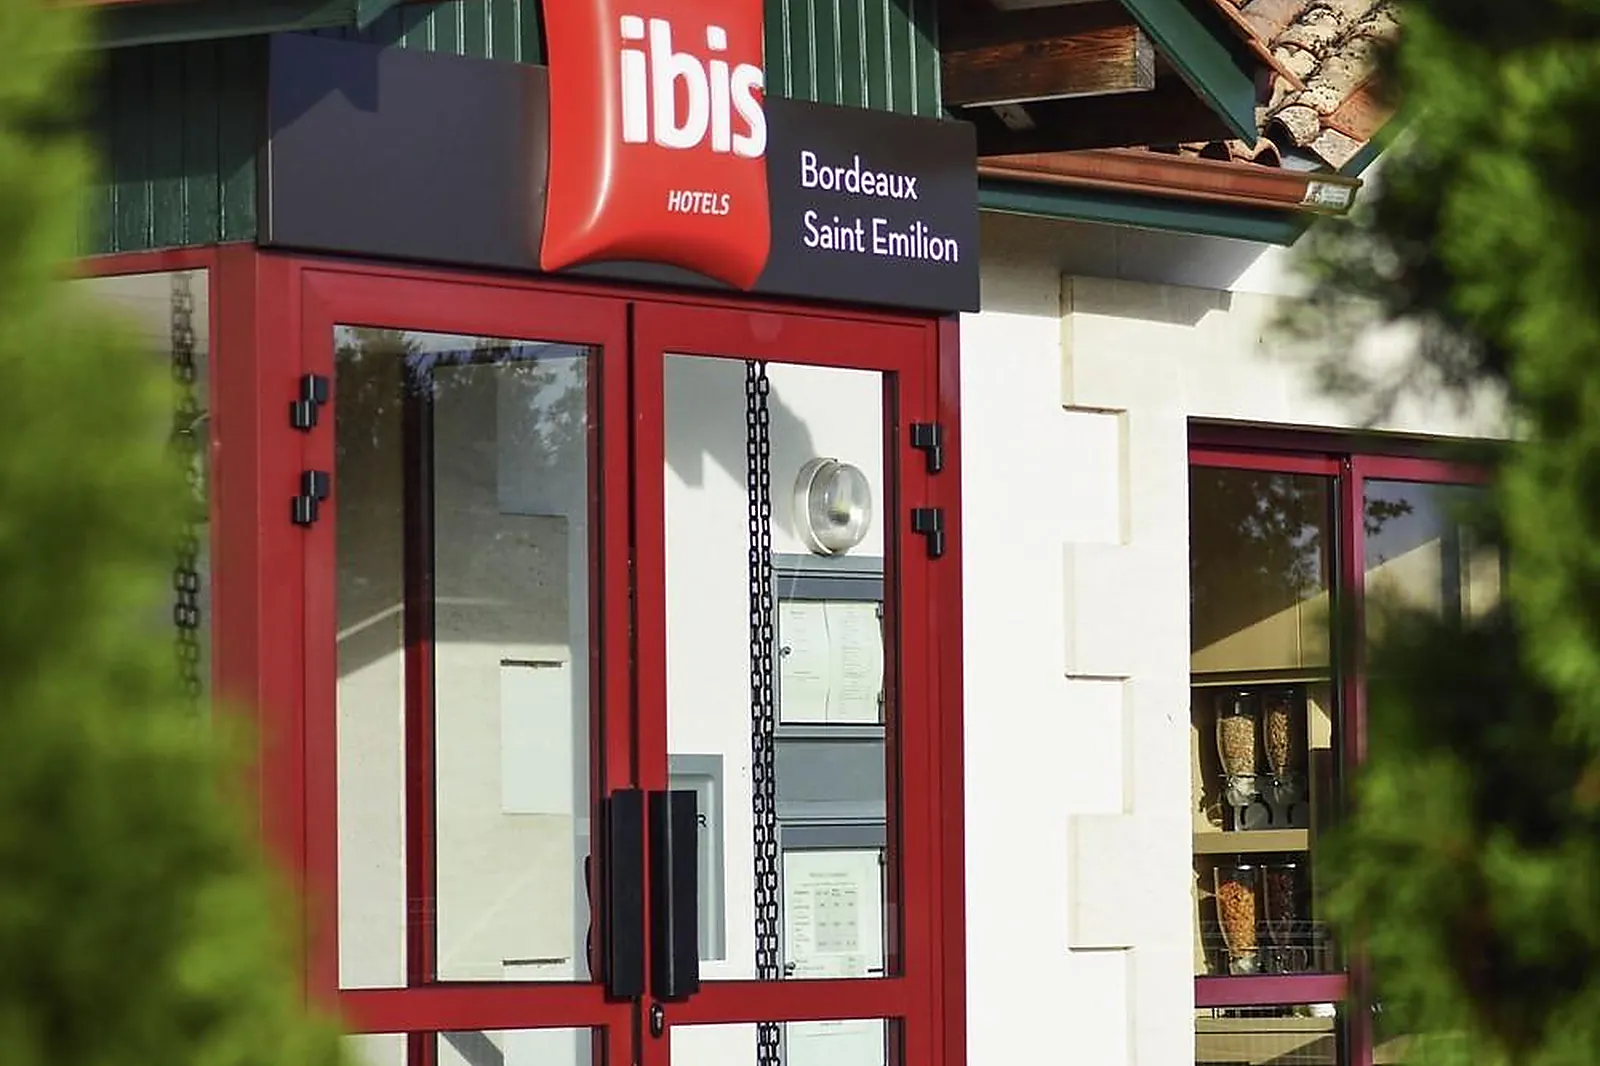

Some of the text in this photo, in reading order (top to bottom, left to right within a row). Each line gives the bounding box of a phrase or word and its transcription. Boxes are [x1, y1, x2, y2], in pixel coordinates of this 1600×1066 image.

[621, 16, 767, 158] ibis
[801, 151, 918, 199] Bordeaux
[668, 190, 730, 215] HOTELS
[804, 210, 959, 262] Saint Emilion
